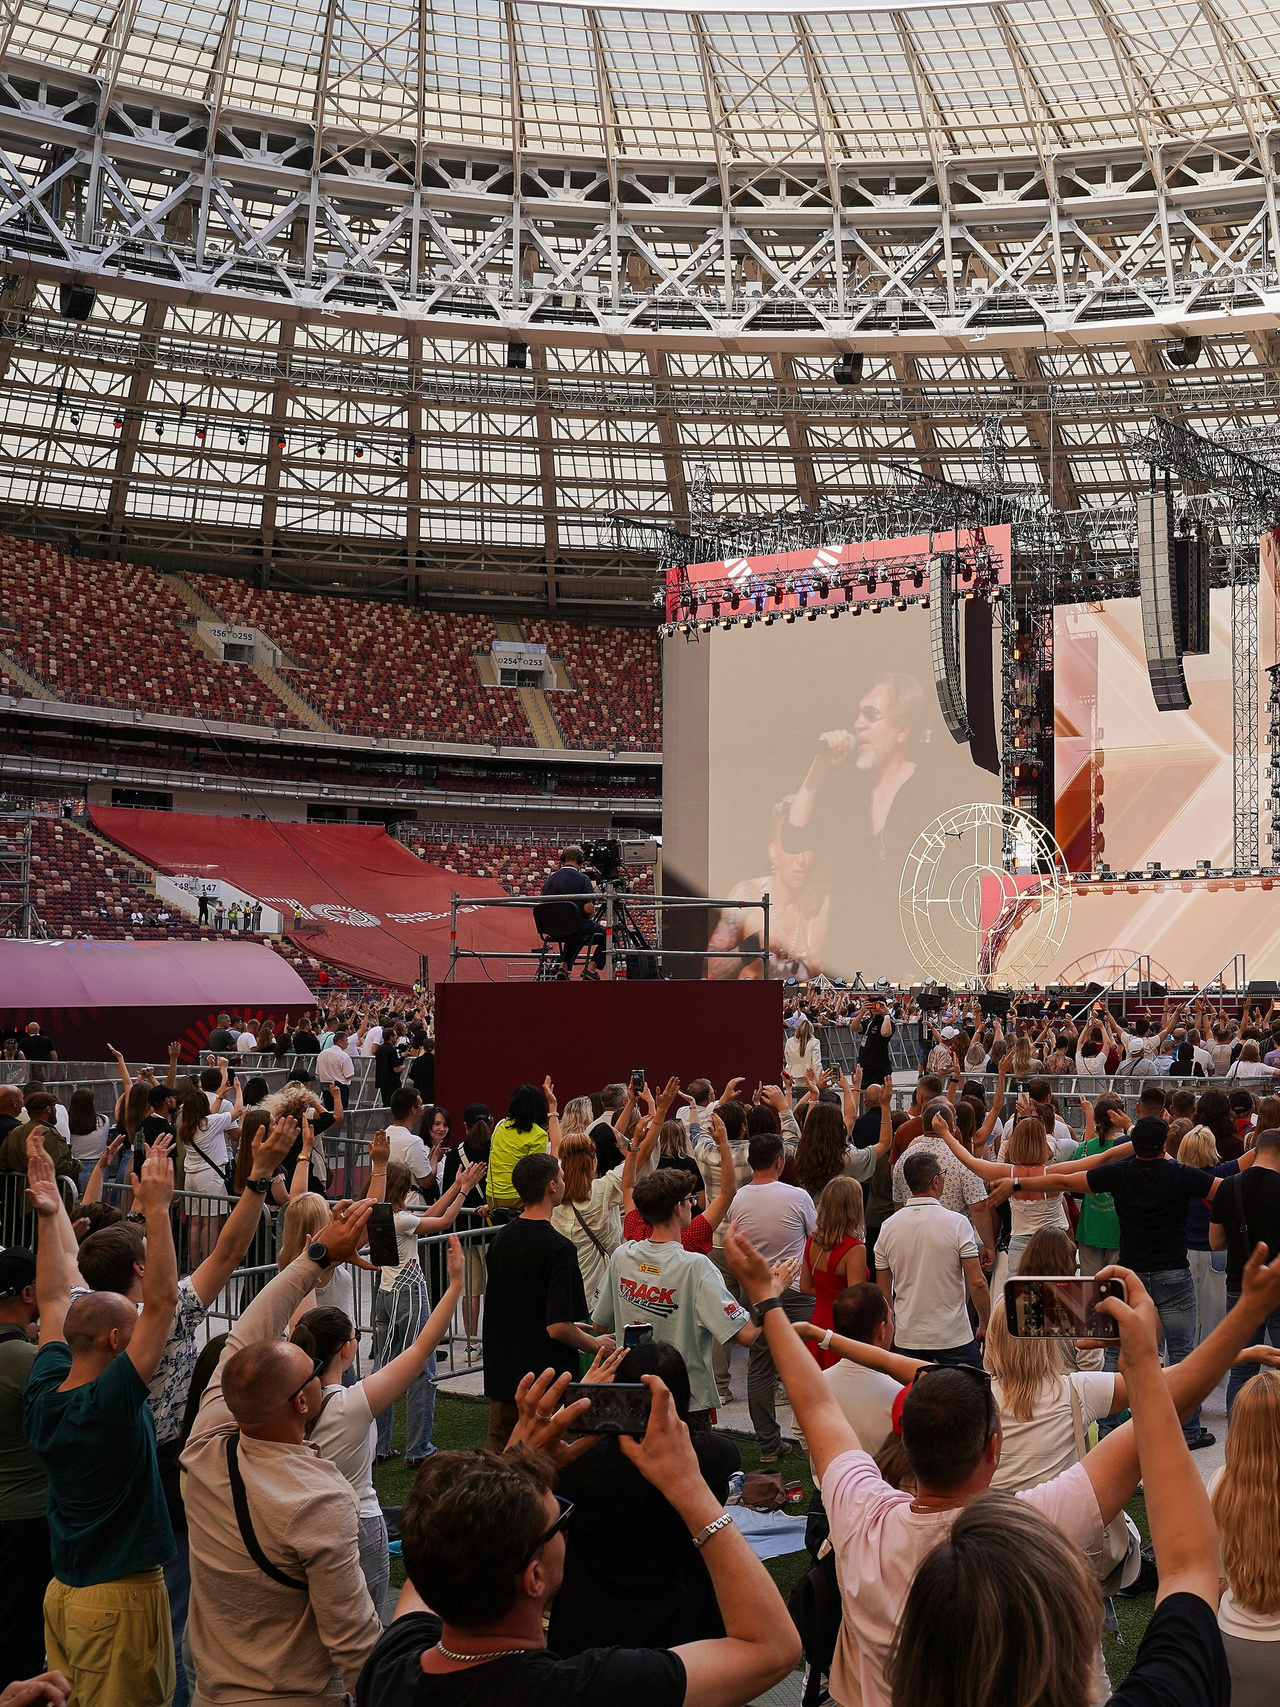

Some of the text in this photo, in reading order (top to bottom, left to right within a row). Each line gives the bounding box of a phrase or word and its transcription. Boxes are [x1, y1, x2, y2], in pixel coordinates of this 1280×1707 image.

[238, 632, 253, 641] 255
[503, 657, 517, 665] 254
[201, 883, 217, 892] 147
[620, 1276, 677, 1304] TRACK
